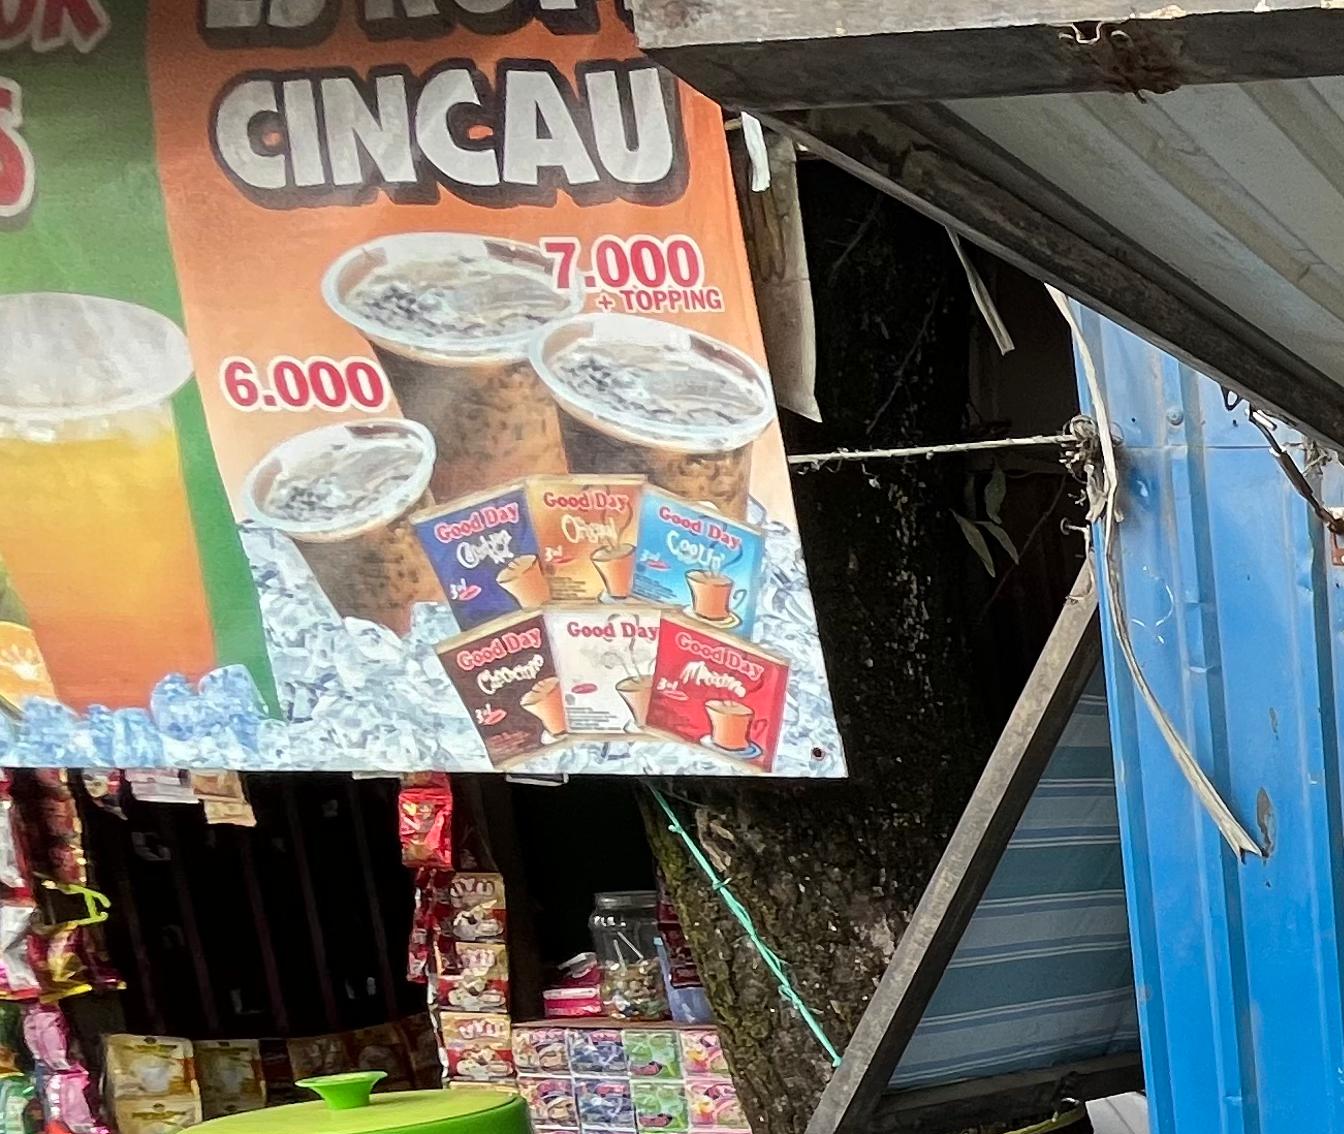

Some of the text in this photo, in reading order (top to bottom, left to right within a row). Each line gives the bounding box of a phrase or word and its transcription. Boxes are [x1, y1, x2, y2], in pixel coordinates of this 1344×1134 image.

[213, 63, 677, 194] CINCAU
[546, 242, 701, 291] 7.000
[623, 288, 723, 311] TOPPING
[224, 360, 385, 408] 6.000
[435, 502, 519, 543] Good Day
[543, 491, 630, 512] Good Day
[659, 506, 743, 550] Good Day
[457, 628, 541, 670] Good Day
[567, 621, 659, 641] Good Day
[676, 632, 724, 665] Good
[725, 652, 764, 681] Day
